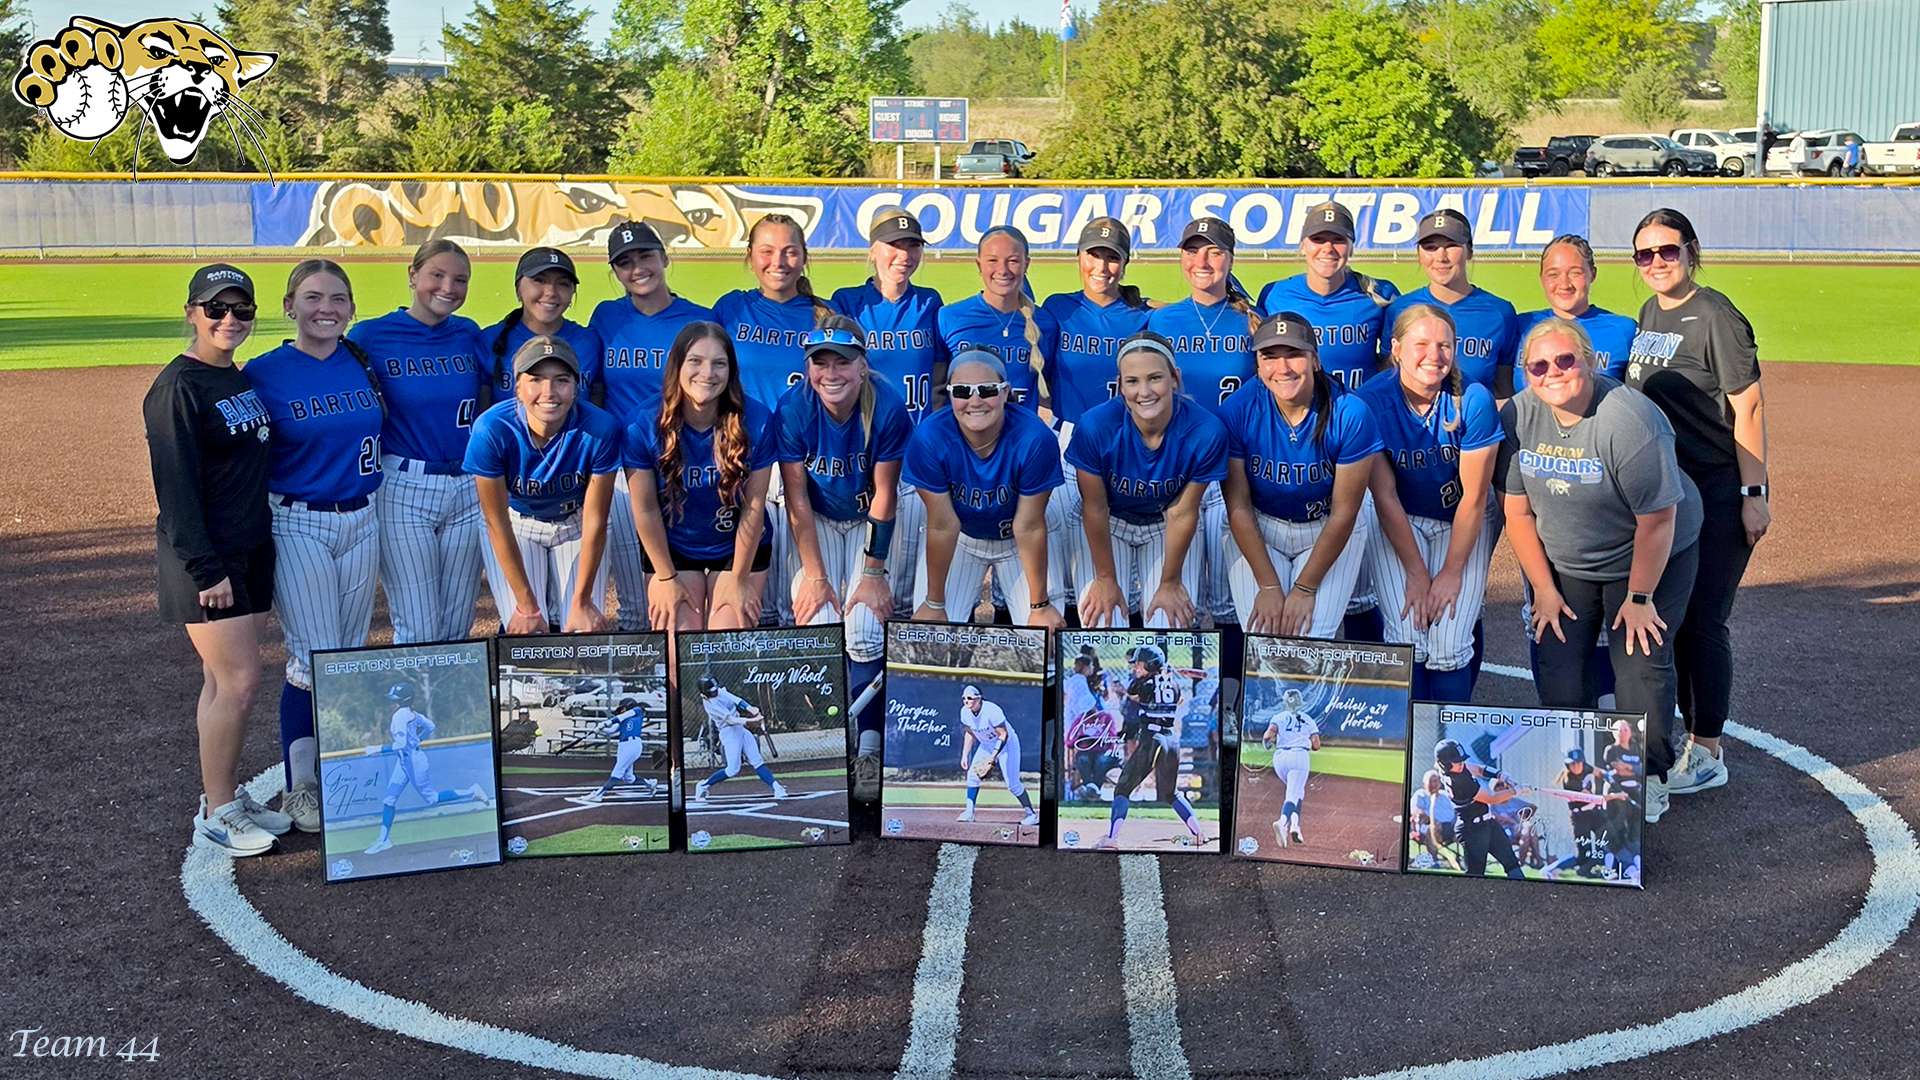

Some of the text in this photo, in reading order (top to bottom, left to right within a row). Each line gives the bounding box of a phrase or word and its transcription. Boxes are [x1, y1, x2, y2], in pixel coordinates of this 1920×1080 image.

[856, 193, 1162, 245] COUGAR
[898, 217, 910, 230] B
[1324, 210, 1335, 222] B
[1434, 216, 1445, 228] B
[1100, 228, 1111, 238] B
[1197, 222, 1208, 233] B
[621, 230, 633, 244] B
[550, 254, 559, 263] B
[1276, 321, 1288, 335] B
[1312, 323, 1370, 346] RTON
[866, 328, 934, 350] ARTON
[1455, 337, 1493, 359] TON
[543, 345, 553, 355] B
[606, 347, 670, 369] BART
[385, 354, 476, 378] BARTON
[903, 373, 930, 411] 10
[288, 388, 380, 421] BARTON
[1536, 443, 1584, 458] BARTON
[1519, 449, 1603, 475] COUGARS
[690, 636, 836, 655] BARTON SOFTBALL
[898, 630, 1037, 648] BARTON SOFTBALL
[1072, 635, 1214, 647] BARTON SOFTBALL
[511, 643, 658, 660] BARTON SOFTBALL
[1258, 643, 1404, 666] BARTON SOFTBALL
[324, 652, 479, 676] BARTON SOFTBALL
[744, 663, 828, 690] Laney Wood
[888, 697, 939, 722] Morgan
[896, 716, 947, 734] Thatcher
[1440, 709, 1620, 732] BARTON SOFTBALL
[1585, 848, 1606, 861] #26
